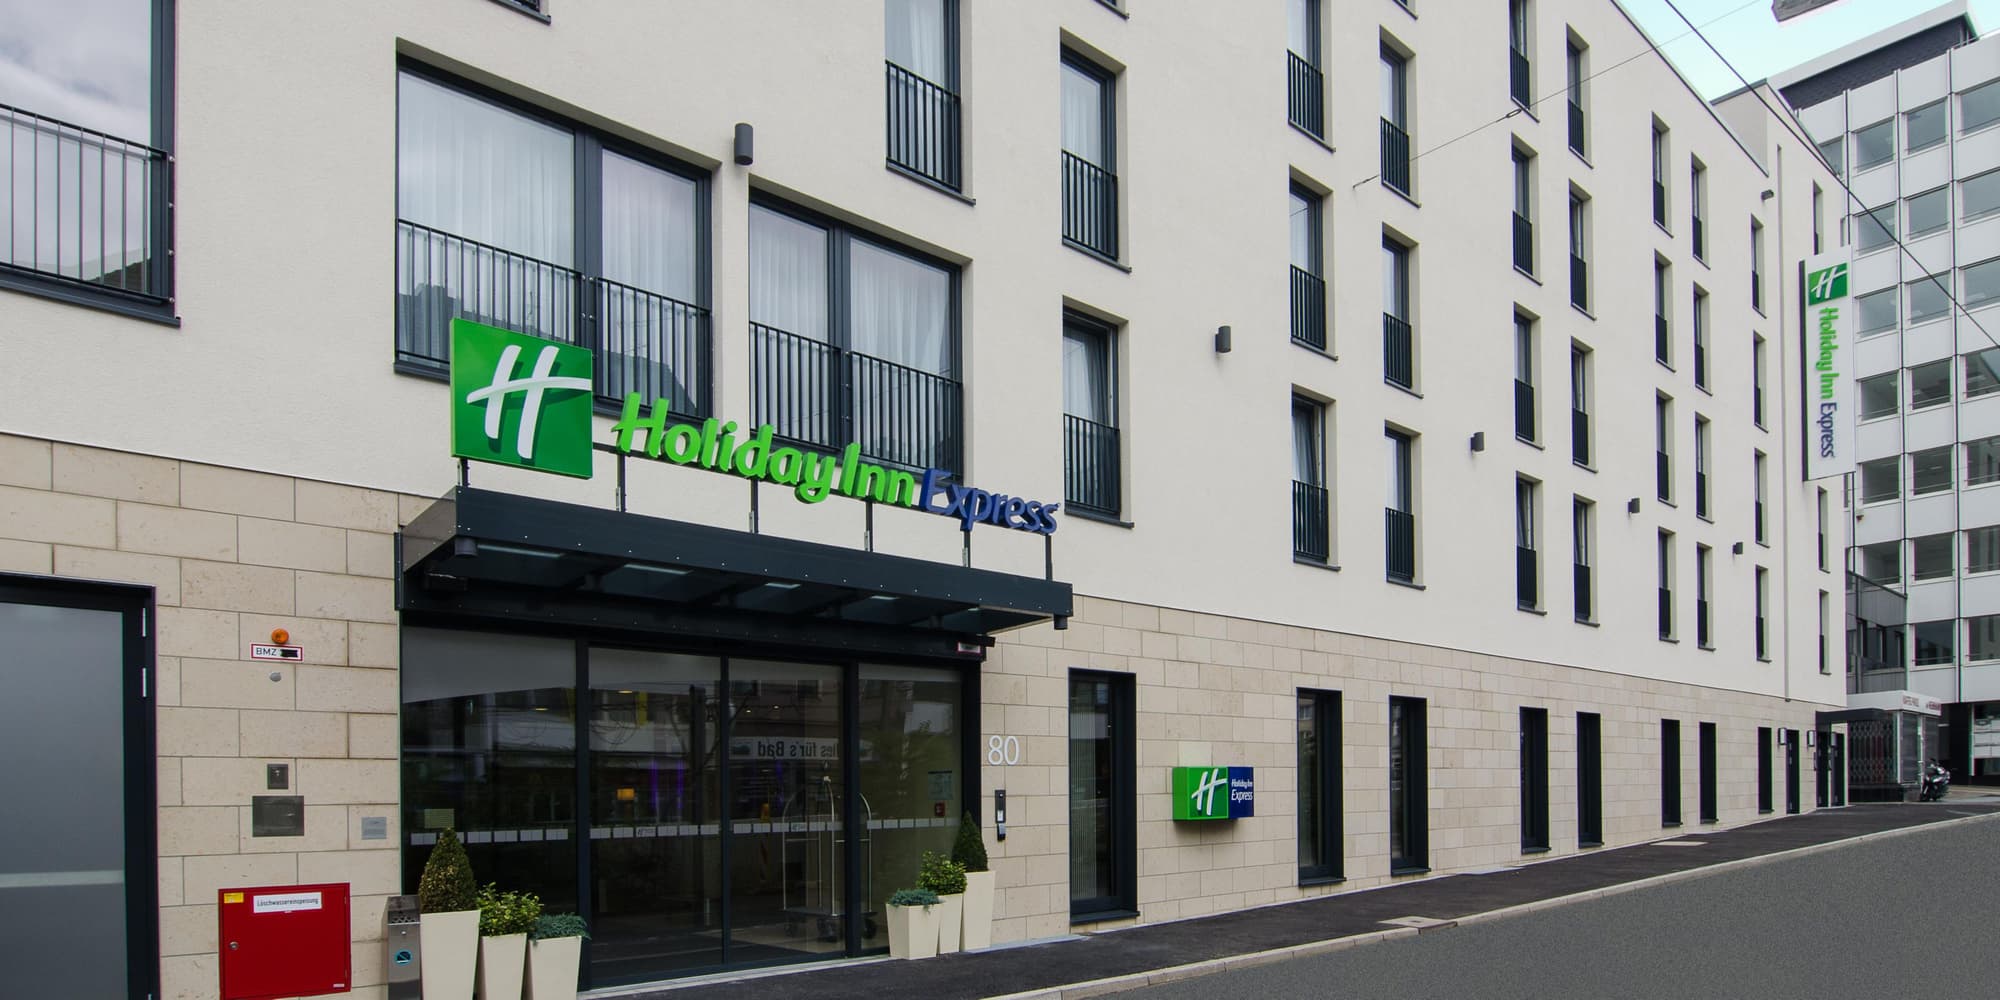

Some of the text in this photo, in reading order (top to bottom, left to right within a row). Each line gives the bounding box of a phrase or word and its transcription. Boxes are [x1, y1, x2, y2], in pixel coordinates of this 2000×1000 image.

[1816, 307, 1840, 458] Holiday Inn Express
[611, 391, 1061, 535] Holiday Inn Express
[255, 647, 277, 657] BMZ
[988, 735, 1020, 766] 80
[1231, 789, 1253, 803] Express
